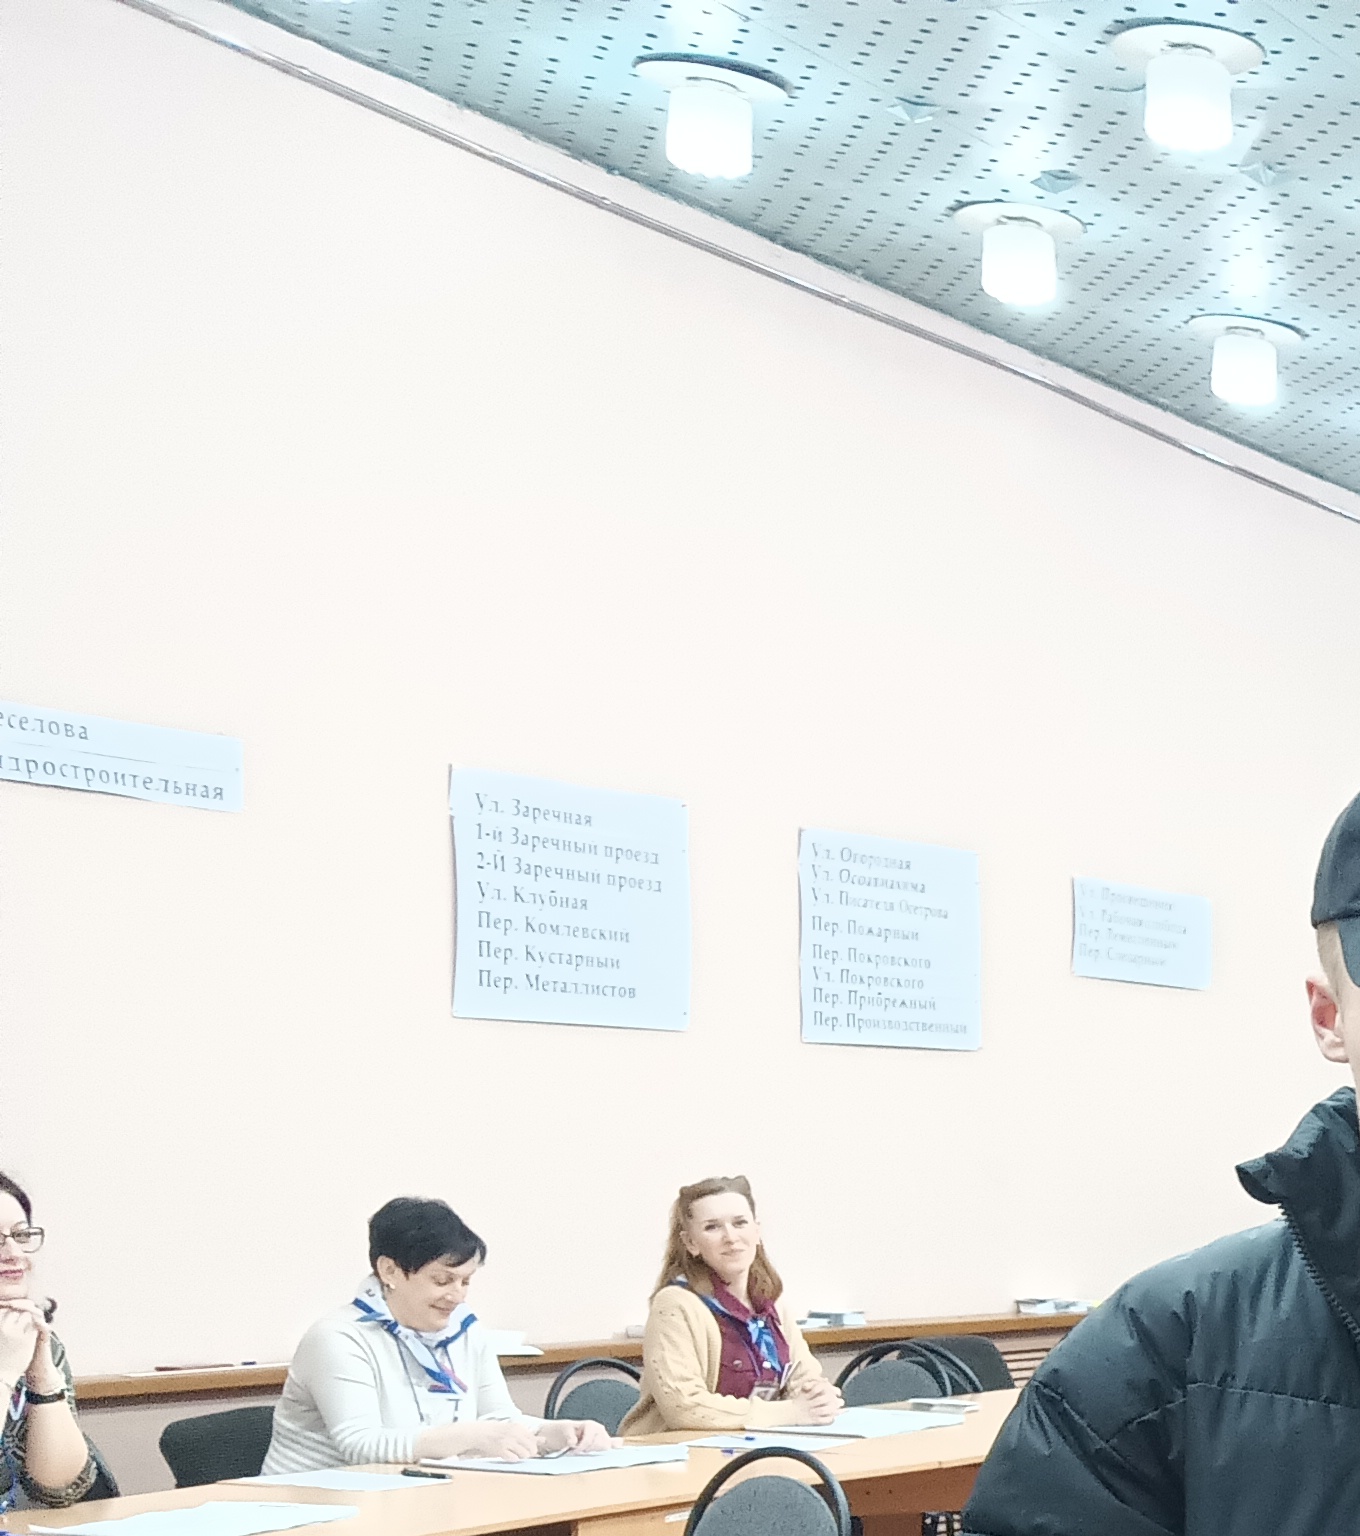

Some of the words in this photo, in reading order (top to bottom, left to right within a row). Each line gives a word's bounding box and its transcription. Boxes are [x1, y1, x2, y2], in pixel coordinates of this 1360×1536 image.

[475, 792, 505, 815] Ул.
[512, 799, 593, 827] Заречная
[476, 822, 503, 843] 1-й
[511, 827, 598, 856] Заречный
[604, 845, 660, 865] проезд
[840, 847, 912, 871] Огородная
[513, 856, 601, 884] Заречный
[606, 873, 662, 893] проезд
[477, 880, 507, 904] Ул.
[513, 885, 588, 911] Клубная
[477, 911, 518, 936] Пер.
[525, 916, 630, 943] Комлевский
[812, 916, 842, 937] Пер.
[847, 919, 919, 942] Пожарный
[478, 940, 518, 965] Пер.
[525, 945, 621, 971] Кустарный
[813, 944, 842, 965] Пер.
[848, 948, 931, 969] Покровского
[478, 969, 518, 994] Пер.
[525, 973, 637, 999] Металлистов
[840, 969, 924, 990] Покровского
[813, 987, 842, 1008] Пер.
[848, 990, 936, 1011] Прибрежный
[813, 1011, 842, 1031] Пер.
[847, 1013, 967, 1035] Производственный
